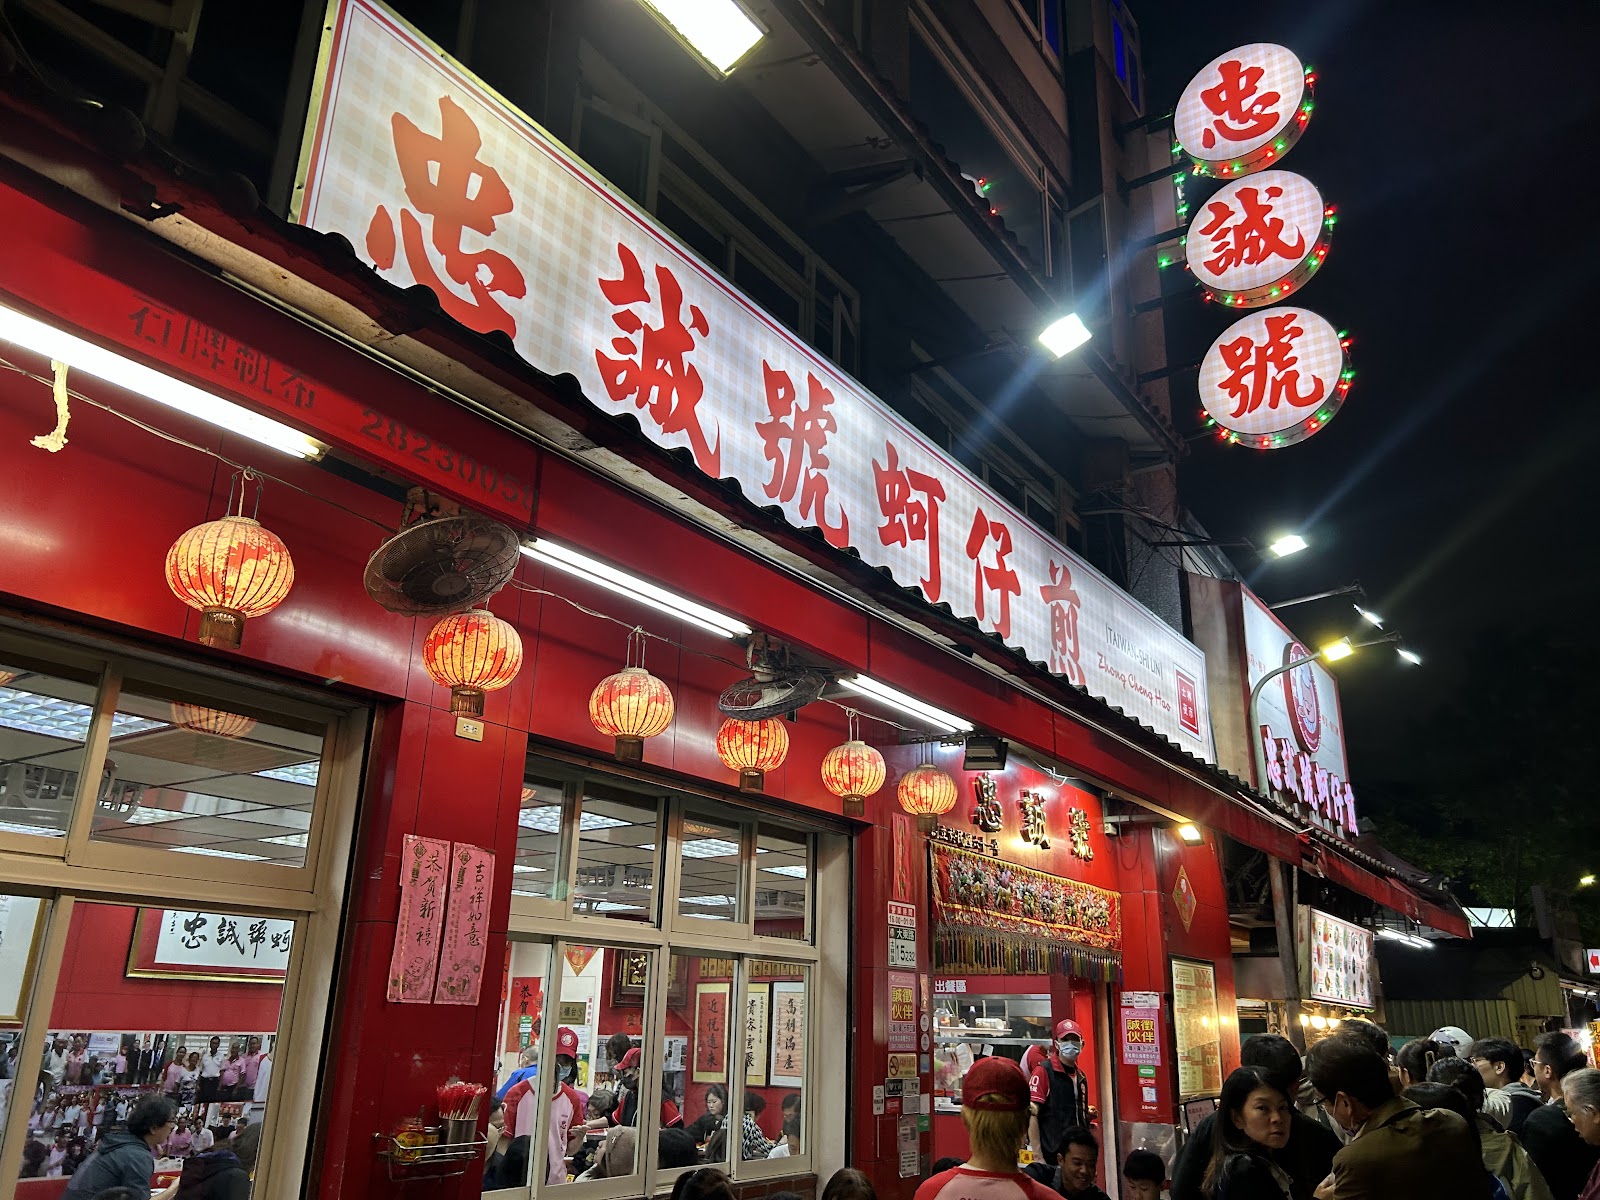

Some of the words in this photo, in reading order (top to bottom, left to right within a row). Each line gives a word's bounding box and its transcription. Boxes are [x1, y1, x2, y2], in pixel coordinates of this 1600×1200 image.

[367, 94, 1086, 686] 忠誠號蚵仔煎
[1097, 651, 1126, 689] Zhong
[1128, 673, 1154, 707] Cheng
[1154, 687, 1171, 712] Hao
[415, 849, 443, 946] 恭賀新禧
[464, 860, 485, 947] 吉祥如意
[892, 1004, 913, 1020] 伙伴
[934, 979, 967, 993] 出餐區
[1127, 1030, 1155, 1043] 伙伴
